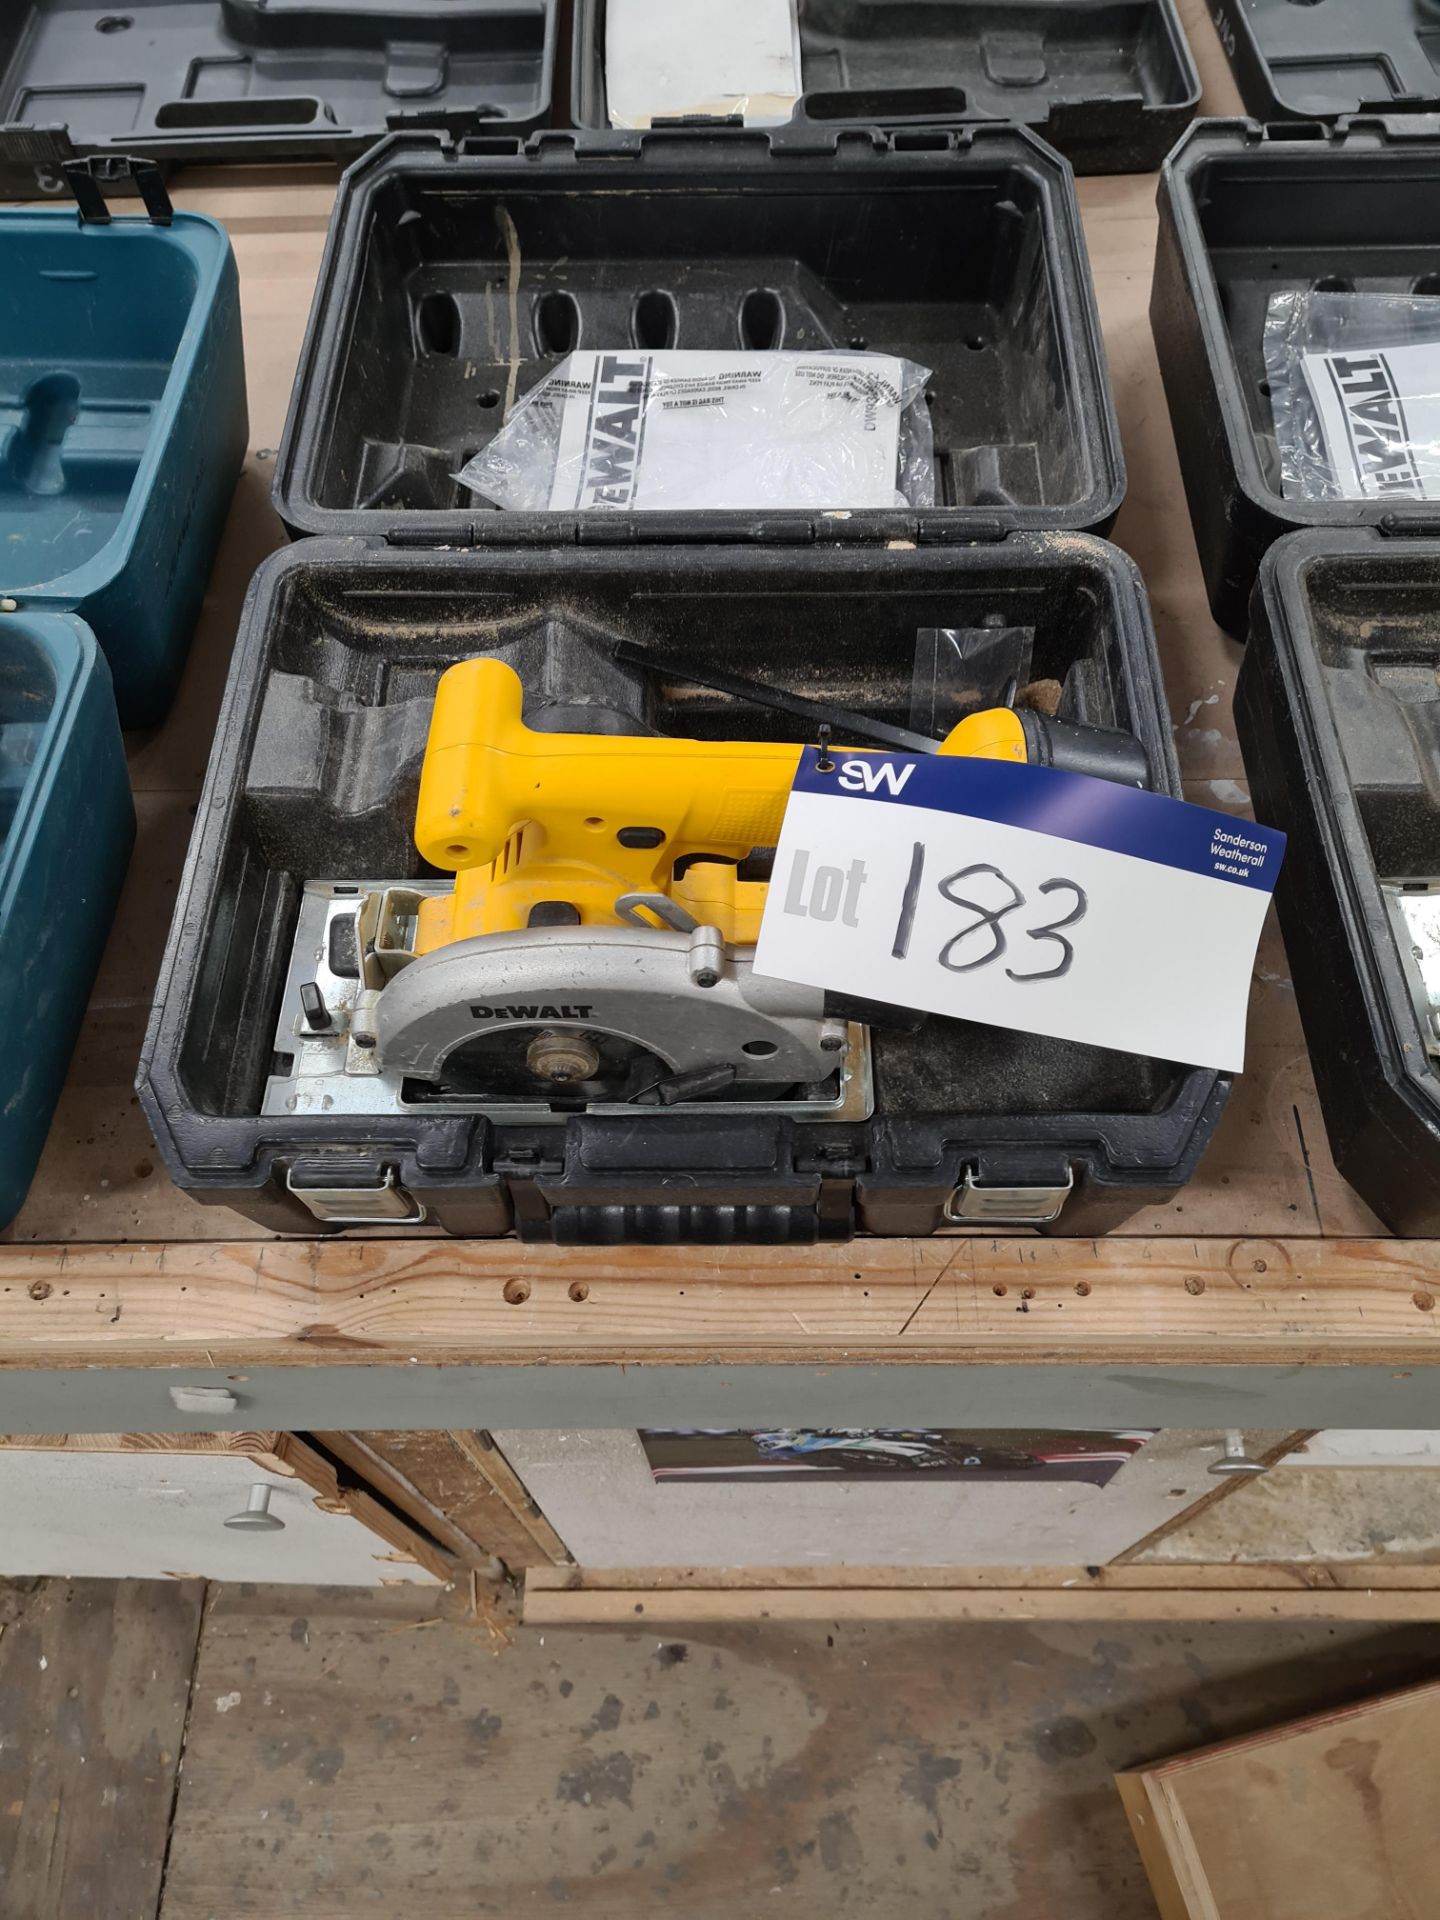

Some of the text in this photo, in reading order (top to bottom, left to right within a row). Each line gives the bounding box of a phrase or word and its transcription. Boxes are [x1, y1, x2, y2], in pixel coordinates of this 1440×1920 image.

[587, 356, 645, 511] EWALT
[1332, 357, 1416, 500] EWALT
[838, 760, 917, 796] SW
[1210, 842, 1266, 868] Weatherall
[1213, 828, 1268, 854] Sanderson
[1214, 862, 1250, 878] sw.co.uk
[783, 841, 1089, 984] Lot 183
